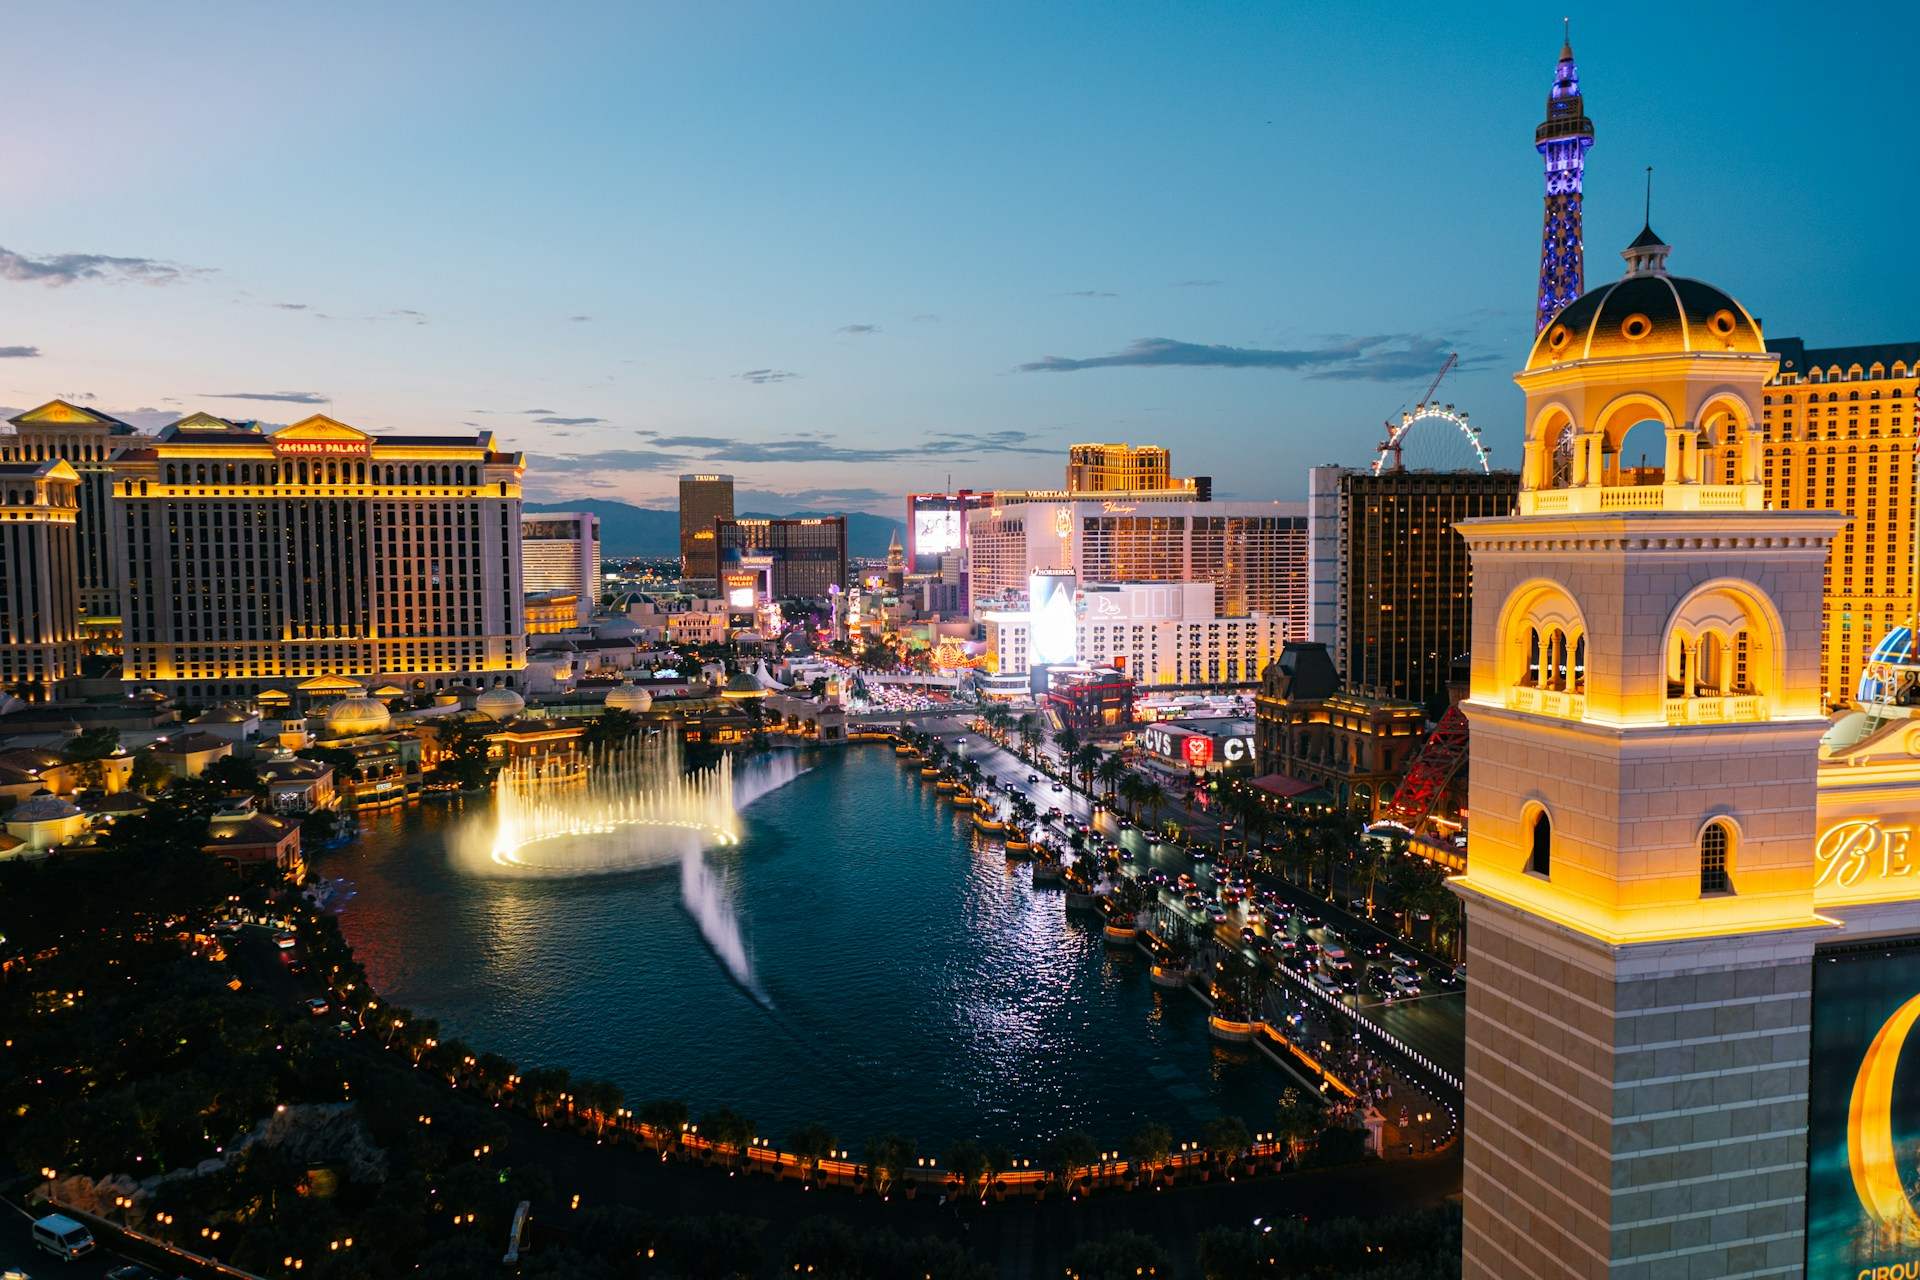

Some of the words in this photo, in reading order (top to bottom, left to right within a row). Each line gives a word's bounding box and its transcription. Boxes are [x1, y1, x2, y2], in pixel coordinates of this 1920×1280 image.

[276, 443, 323, 452] CAESARS
[325, 443, 366, 452] PALACE
[1027, 490, 1070, 498] VENETIAN
[521, 523, 545, 537] OVE
[1038, 568, 1075, 576] HORSESHOE
[1145, 728, 1171, 756] CVS
[1814, 818, 1920, 889] BE
